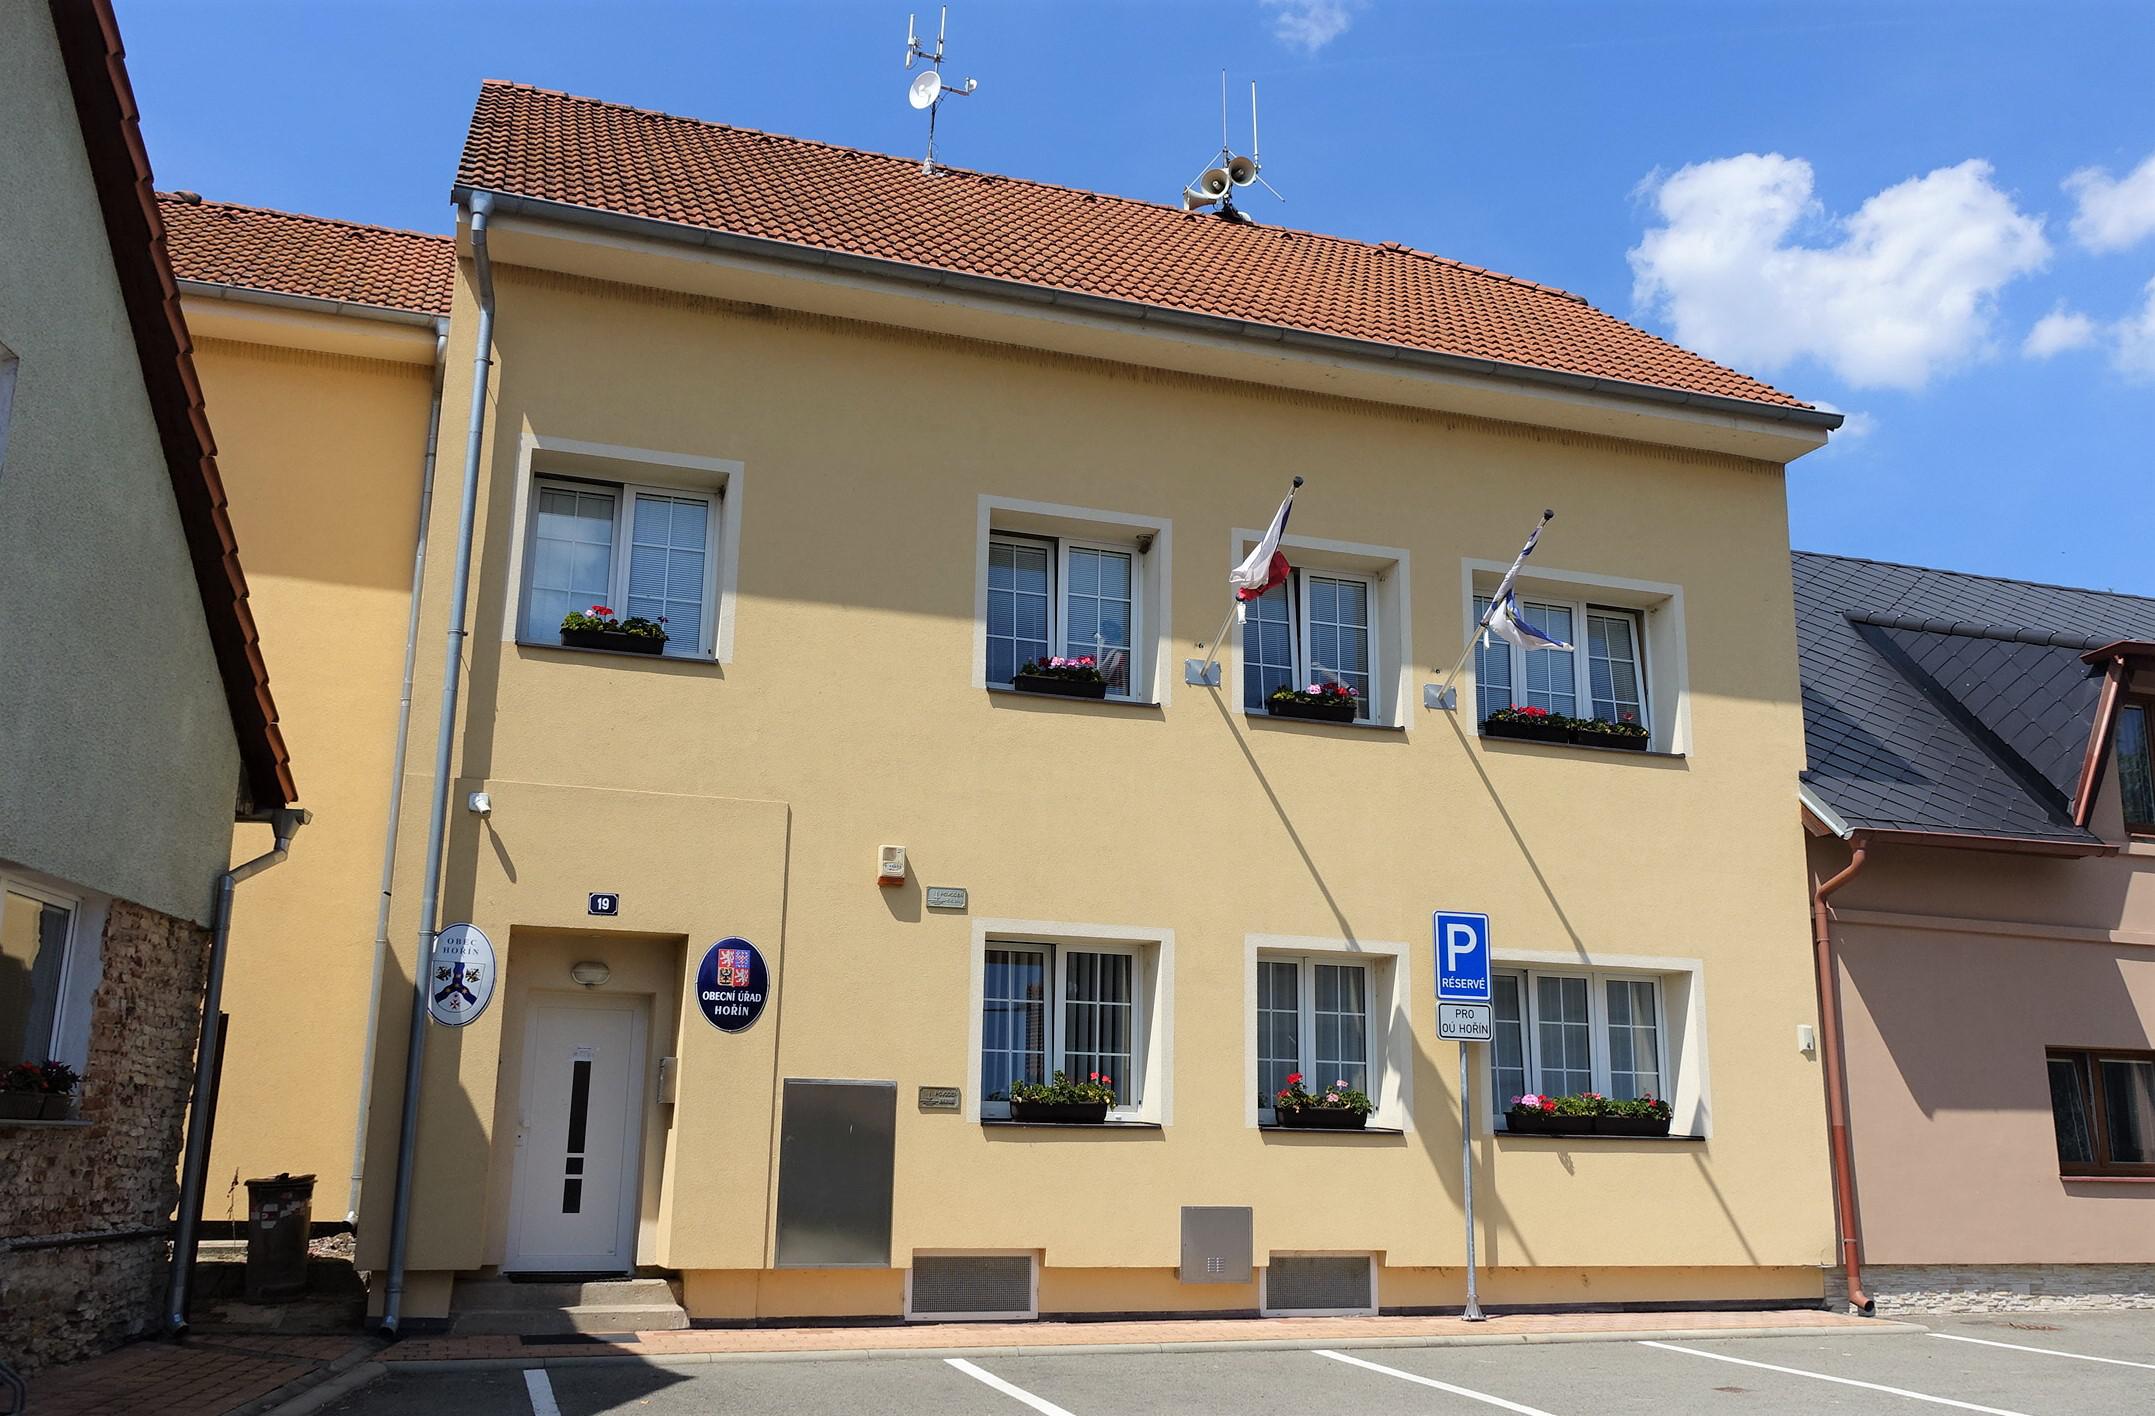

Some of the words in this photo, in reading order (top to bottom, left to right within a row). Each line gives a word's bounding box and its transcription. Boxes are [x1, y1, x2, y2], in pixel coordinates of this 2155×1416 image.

[597, 897, 610, 910] 19
[447, 937, 477, 946] OBEC
[1446, 923, 1477, 972] P
[1442, 976, 1486, 989] RÉSERVÉ
[702, 991, 736, 1002] OBECNÍ
[738, 990, 762, 1003] ÚŘAD
[714, 1003, 750, 1016] HOŘÍN
[1455, 1009, 1475, 1019] PRO
[1459, 1022, 1488, 1034] HOŘÍN
